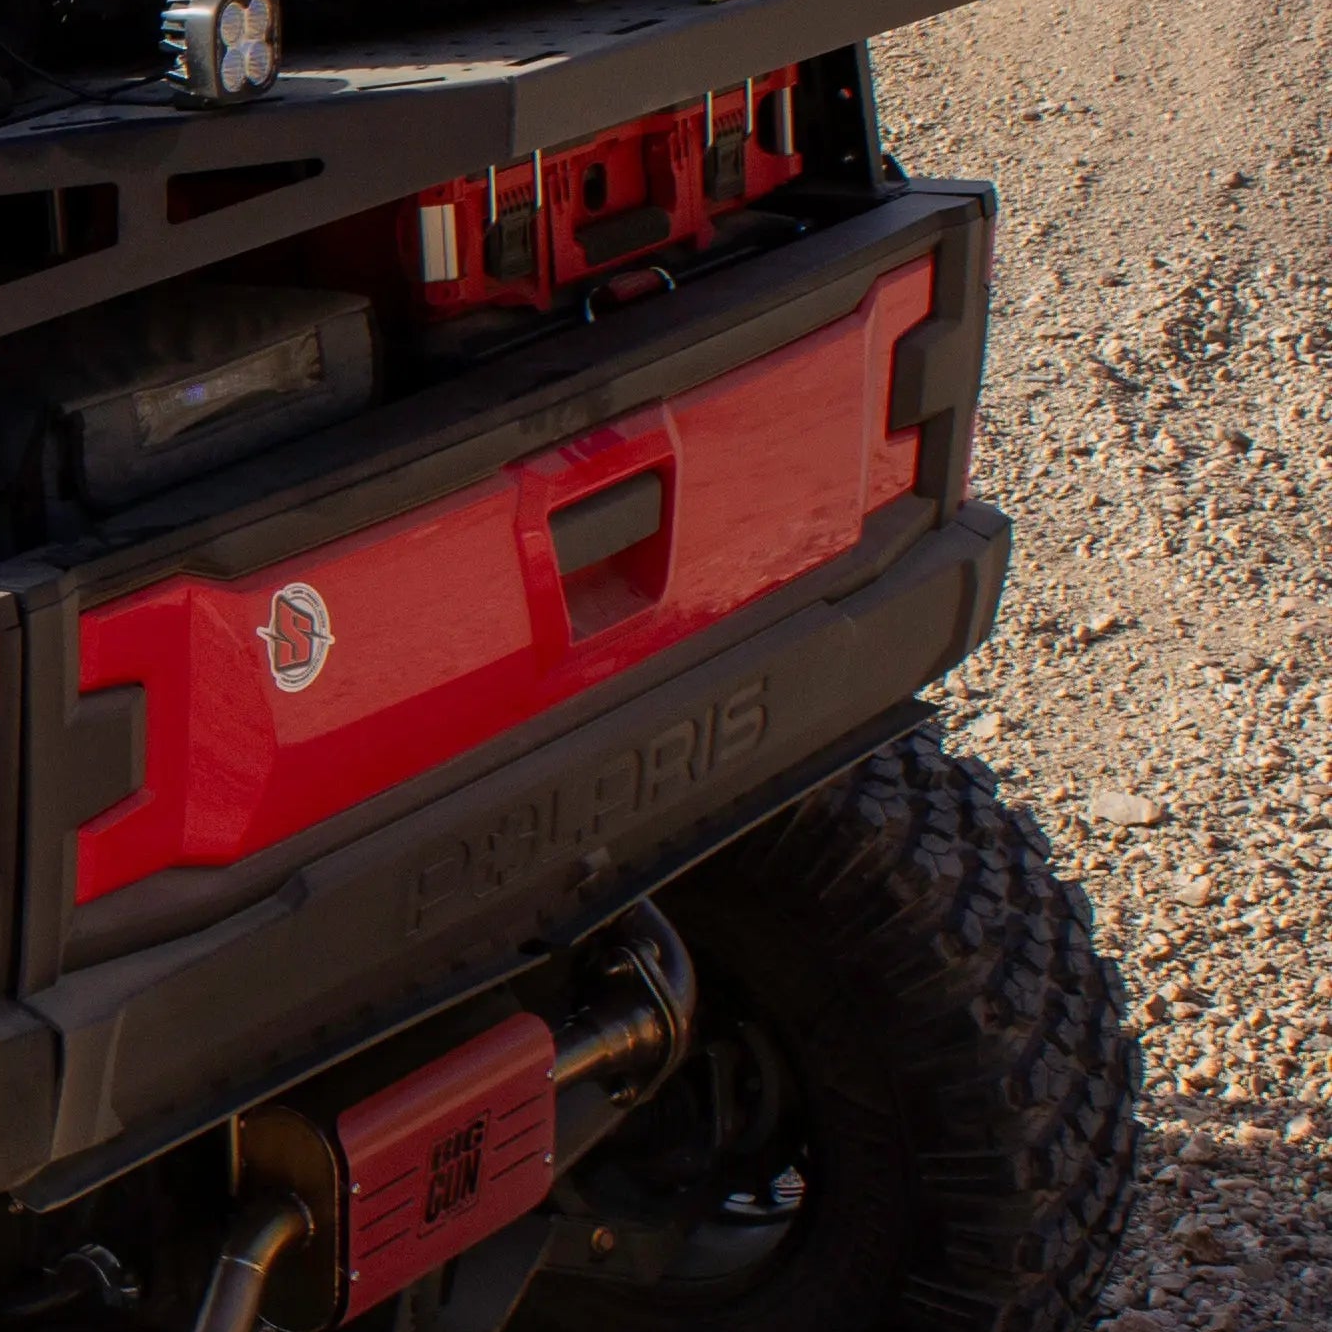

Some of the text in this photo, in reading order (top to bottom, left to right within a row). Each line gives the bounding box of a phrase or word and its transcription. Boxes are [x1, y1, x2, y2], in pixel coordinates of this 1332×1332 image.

[405, 674, 768, 937] POLARIS
[432, 1119, 486, 1173] BIG
[425, 1148, 482, 1224] GUN
